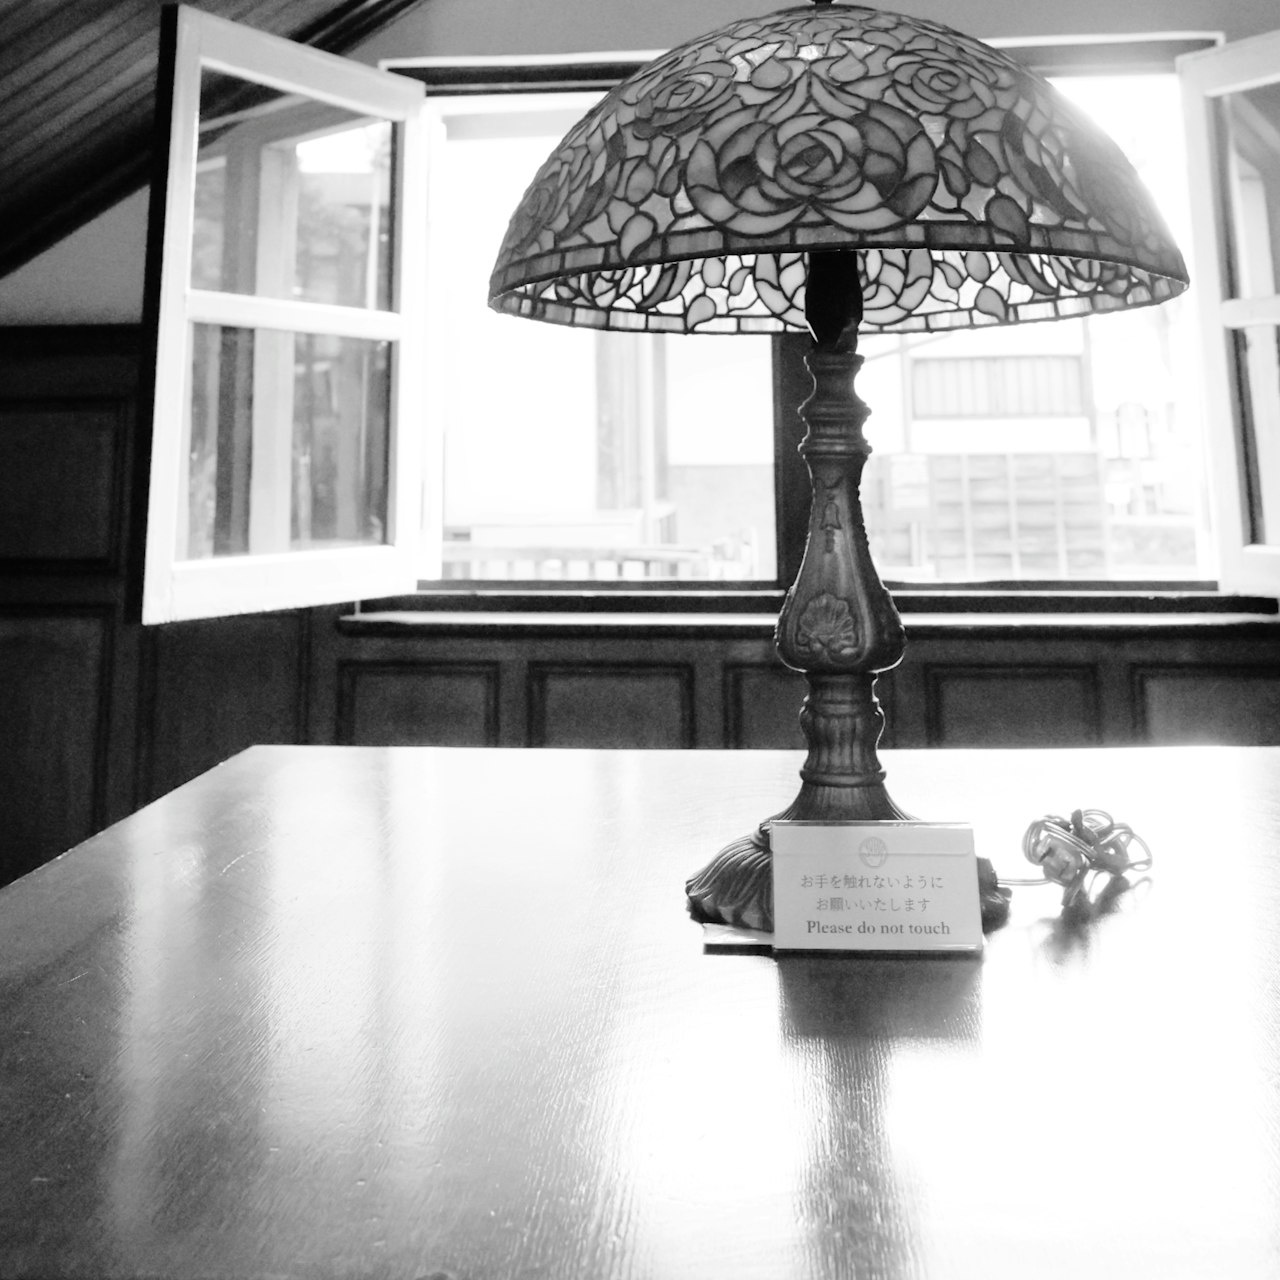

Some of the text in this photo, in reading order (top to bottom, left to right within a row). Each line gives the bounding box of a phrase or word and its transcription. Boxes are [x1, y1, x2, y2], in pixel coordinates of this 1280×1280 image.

[801, 874, 944, 889] お手を触れないように
[816, 897, 931, 912] お願いいたします
[806, 920, 951, 935] Please do not touch
